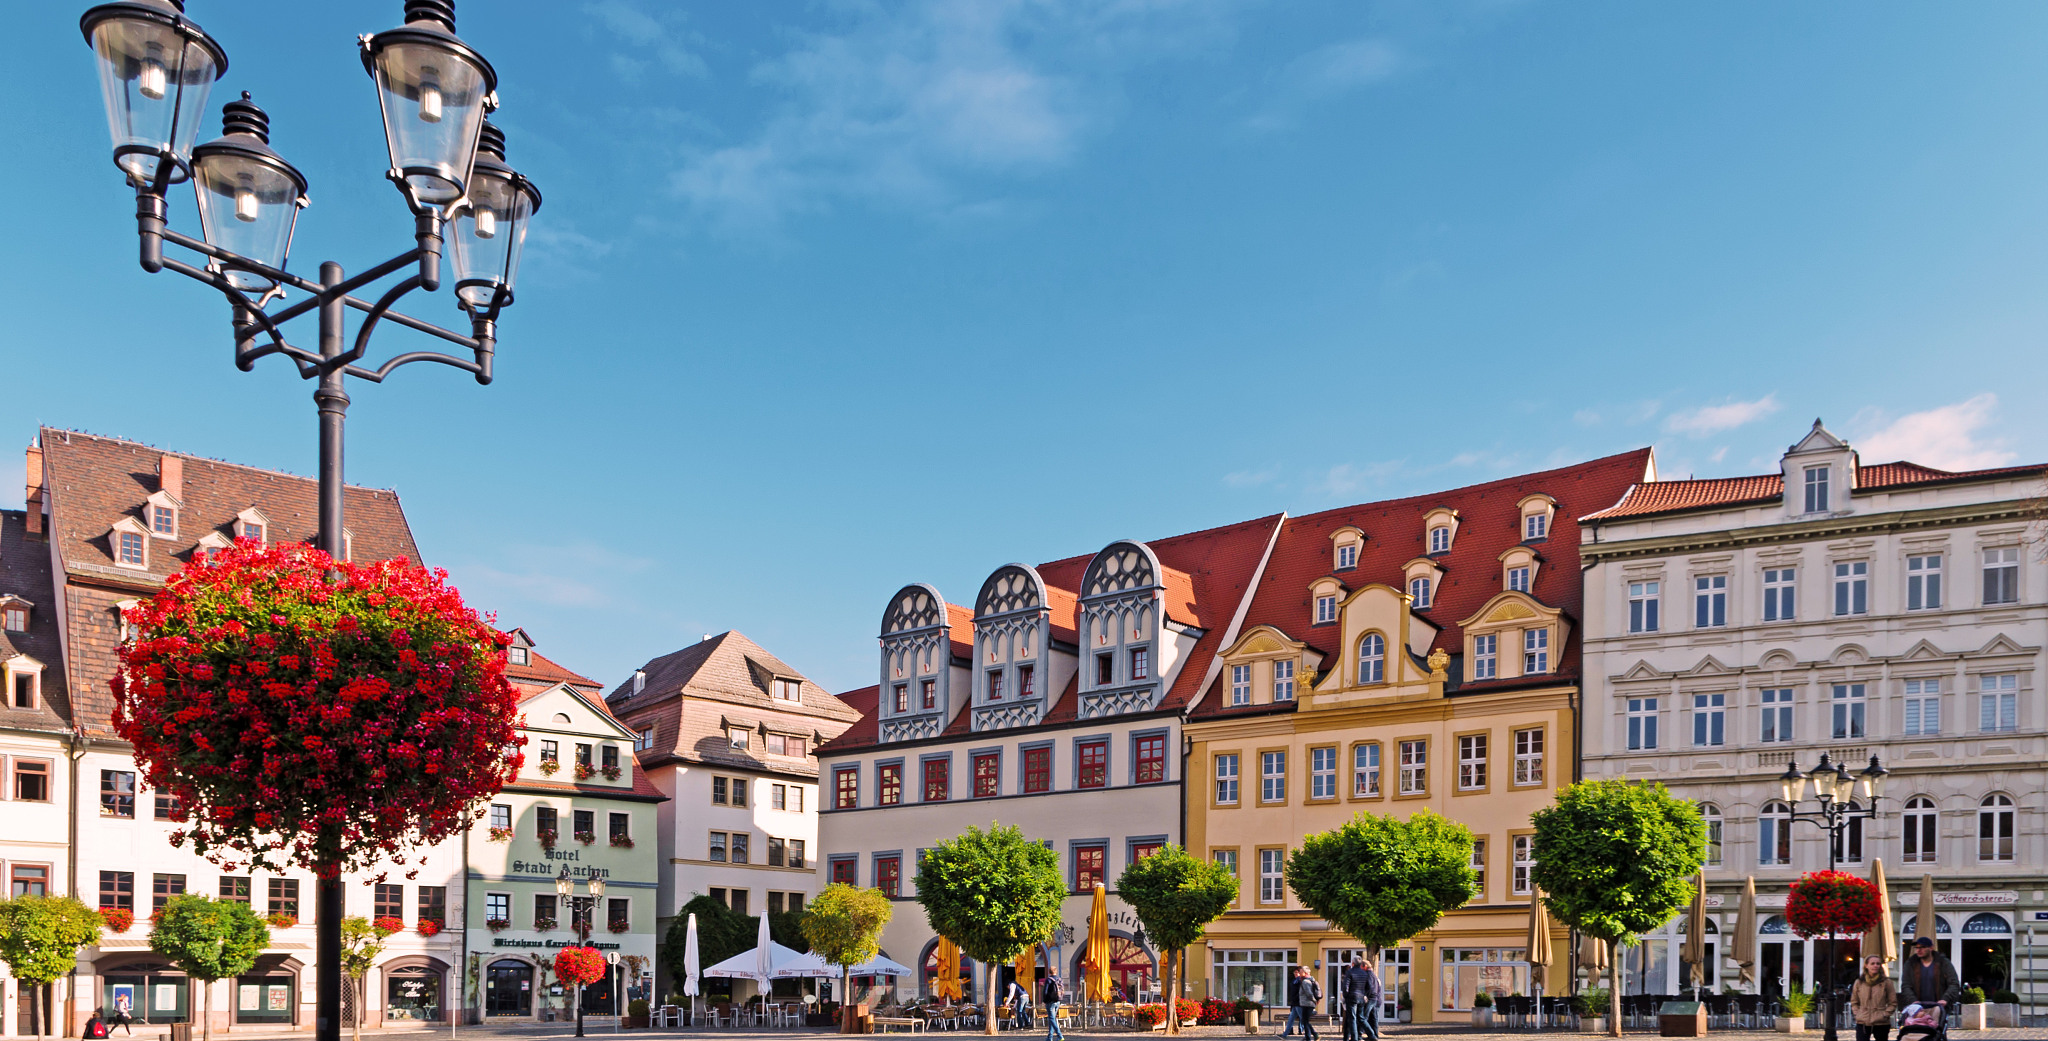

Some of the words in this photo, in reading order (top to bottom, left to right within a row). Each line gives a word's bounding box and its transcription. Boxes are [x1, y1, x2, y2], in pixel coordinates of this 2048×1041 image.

[544, 847, 579, 861] Hotel
[512, 860, 552, 874] Stadt
[1936, 893, 2012, 904] Kaffeerösterei
[1086, 911, 1139, 929] nzlei
